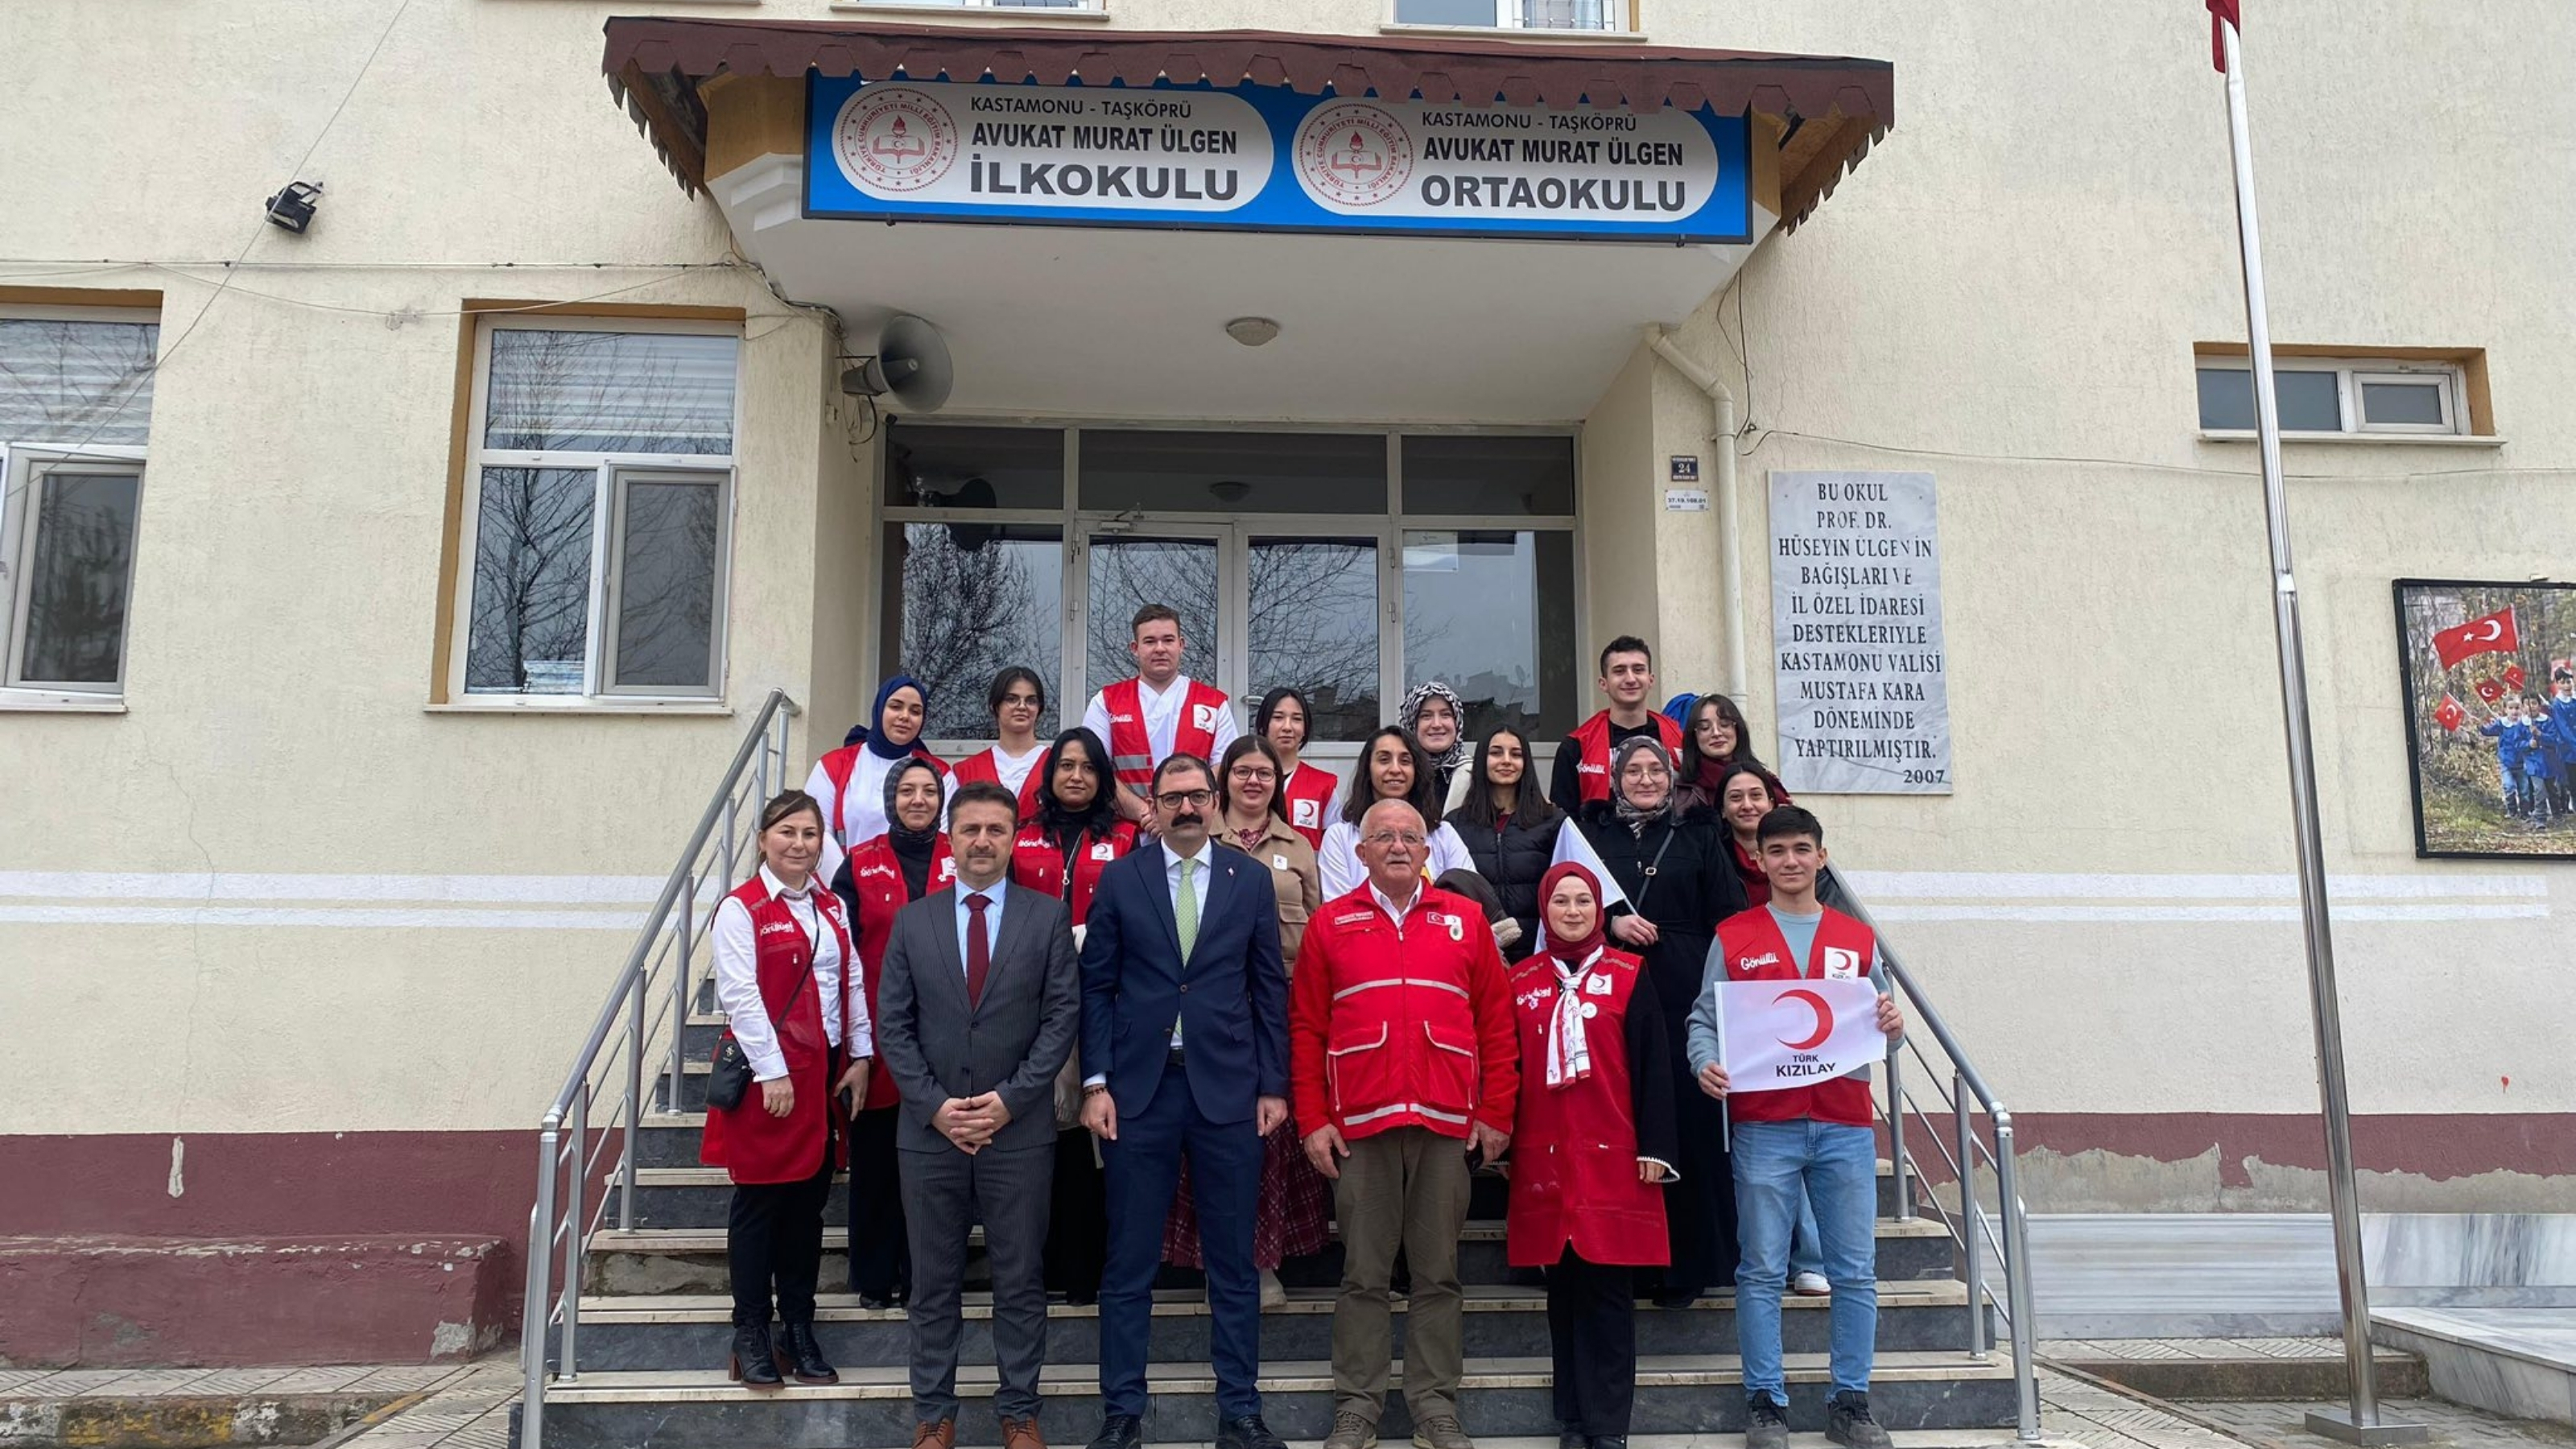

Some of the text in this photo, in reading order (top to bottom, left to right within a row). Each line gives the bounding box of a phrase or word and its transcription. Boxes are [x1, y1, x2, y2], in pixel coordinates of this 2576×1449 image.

[971, 97, 1084, 114] KASTAMONU
[1101, 98, 1191, 120] TAŞKÖPRÜ
[1422, 111, 1532, 129] KASTAMONU
[1549, 112, 1637, 134] TAŞKÖPRÜ
[971, 122, 1237, 155] AVUKAT MURAT ÜLGEN
[1423, 136, 1683, 166] AVUKAT MURAT ÜLGEN
[970, 153, 1238, 201] İLKOKULU
[1421, 174, 1686, 212] ORTAOKULU
[1678, 462, 1691, 474] 24
[1817, 482, 1889, 502] BU OKUL
[1864, 510, 1892, 530] DR.
[1801, 561, 1913, 590] BAĞIŞLARI VE
[1791, 591, 1925, 617] İL ÖZEL İDARESİ
[1781, 650, 1942, 674] KASTAMONU VALİSİ
[1800, 680, 1926, 701] MUSTAFA KARA
[1813, 705, 1916, 730] DÖNEMİNDE
[1902, 769, 1946, 785] 2007
[1740, 951, 1781, 971] Gönüllü
[1792, 1053, 1819, 1063] TÜRK
[1775, 1062, 1836, 1078] KIZILAY
